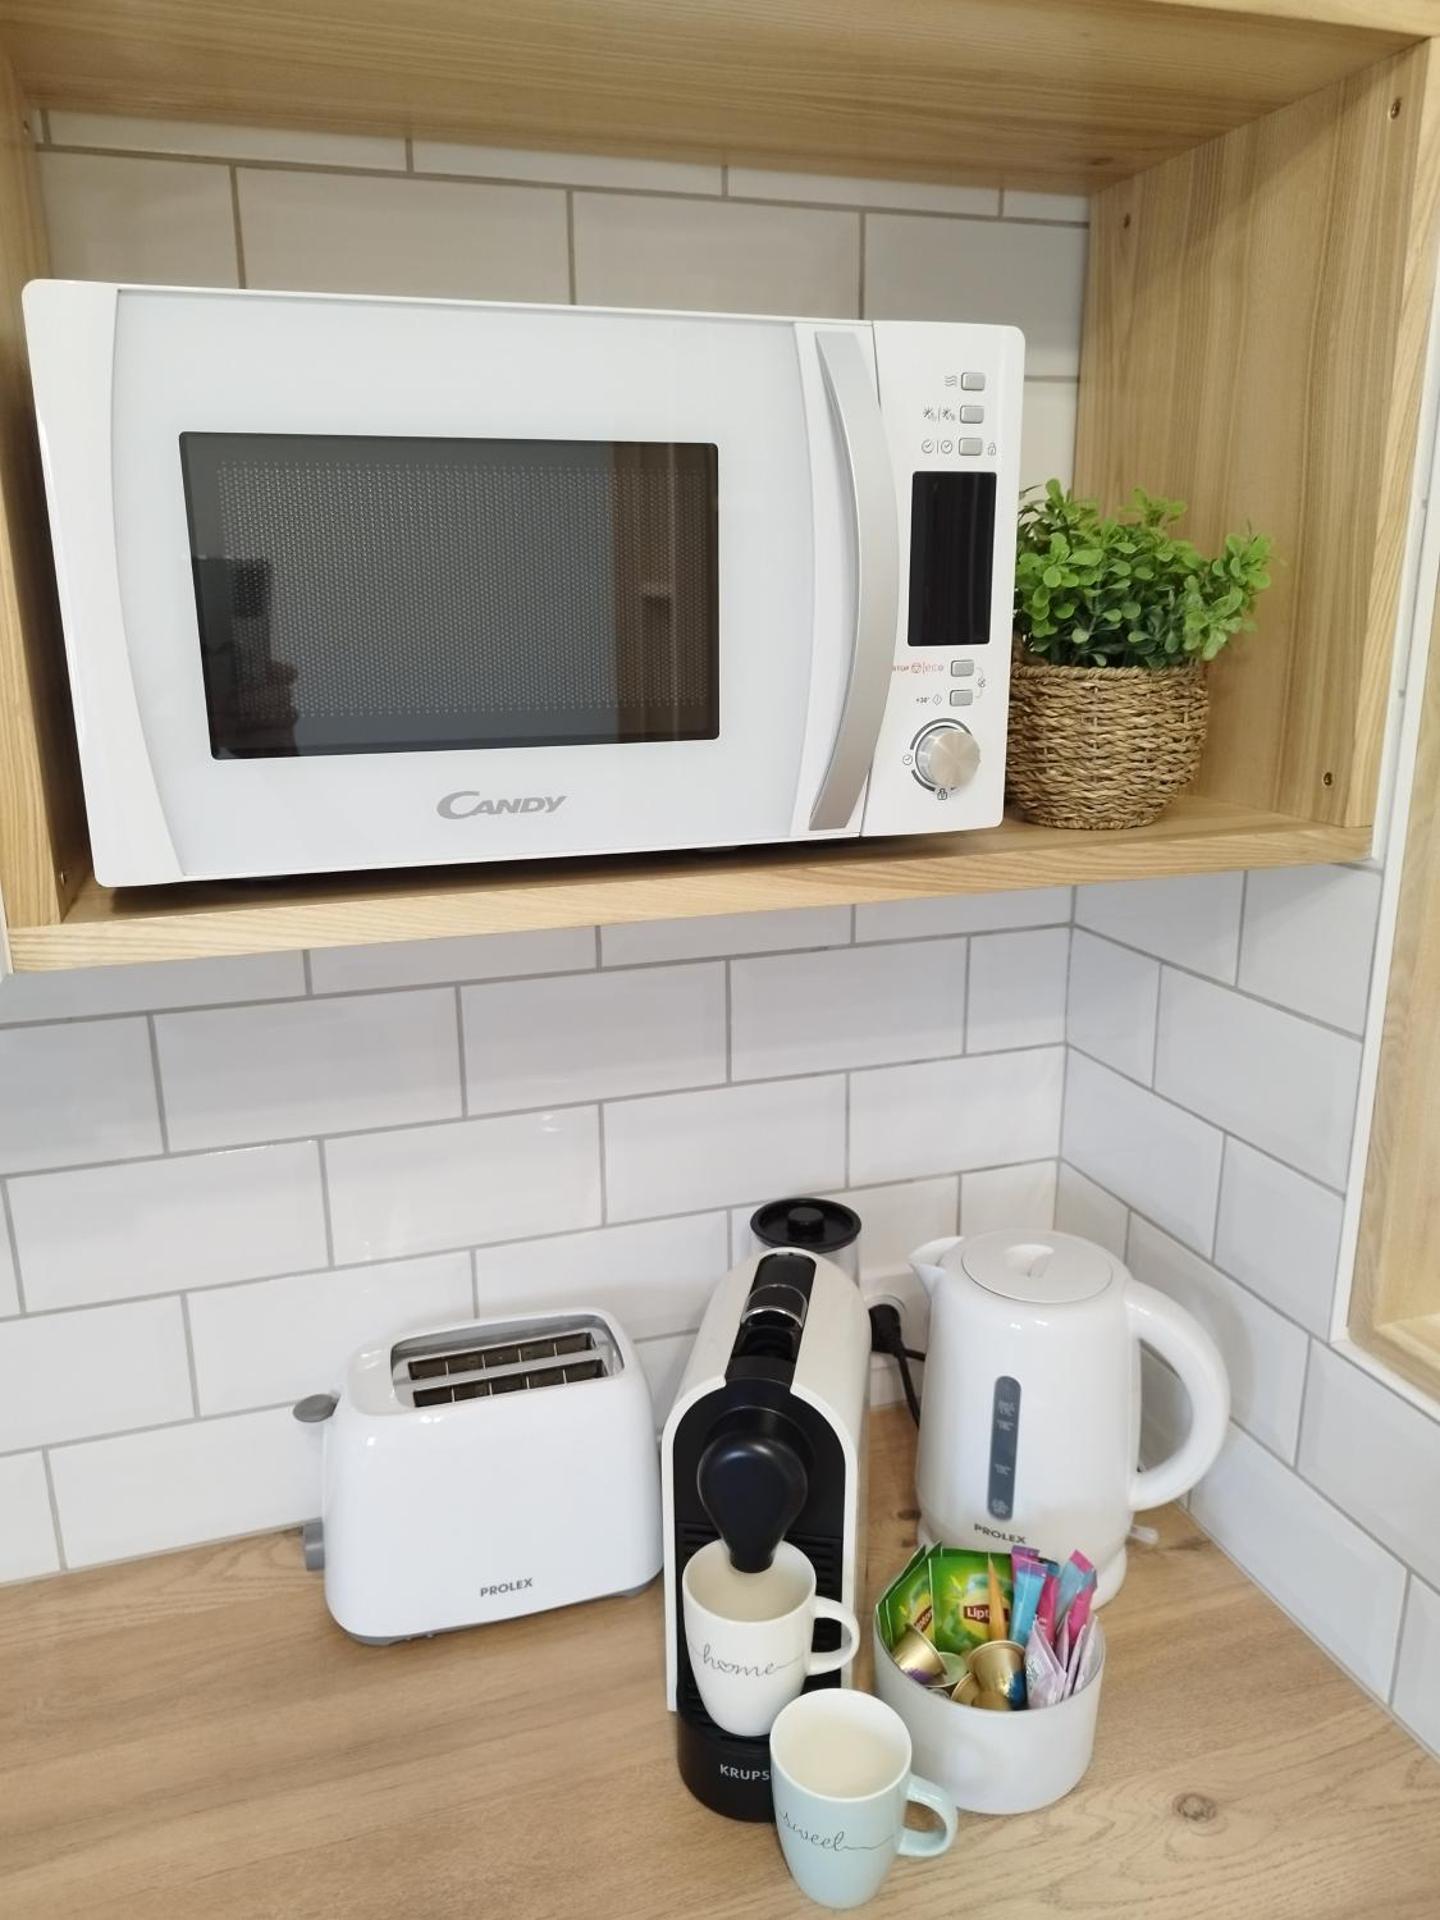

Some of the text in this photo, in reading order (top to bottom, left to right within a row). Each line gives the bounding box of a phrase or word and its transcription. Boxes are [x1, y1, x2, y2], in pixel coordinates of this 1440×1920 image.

[974, 1523, 1026, 1544] PROLEX
[480, 1577, 533, 1597] PROLEX
[703, 1643, 775, 1677] home
[720, 1763, 770, 1781] KRUPS
